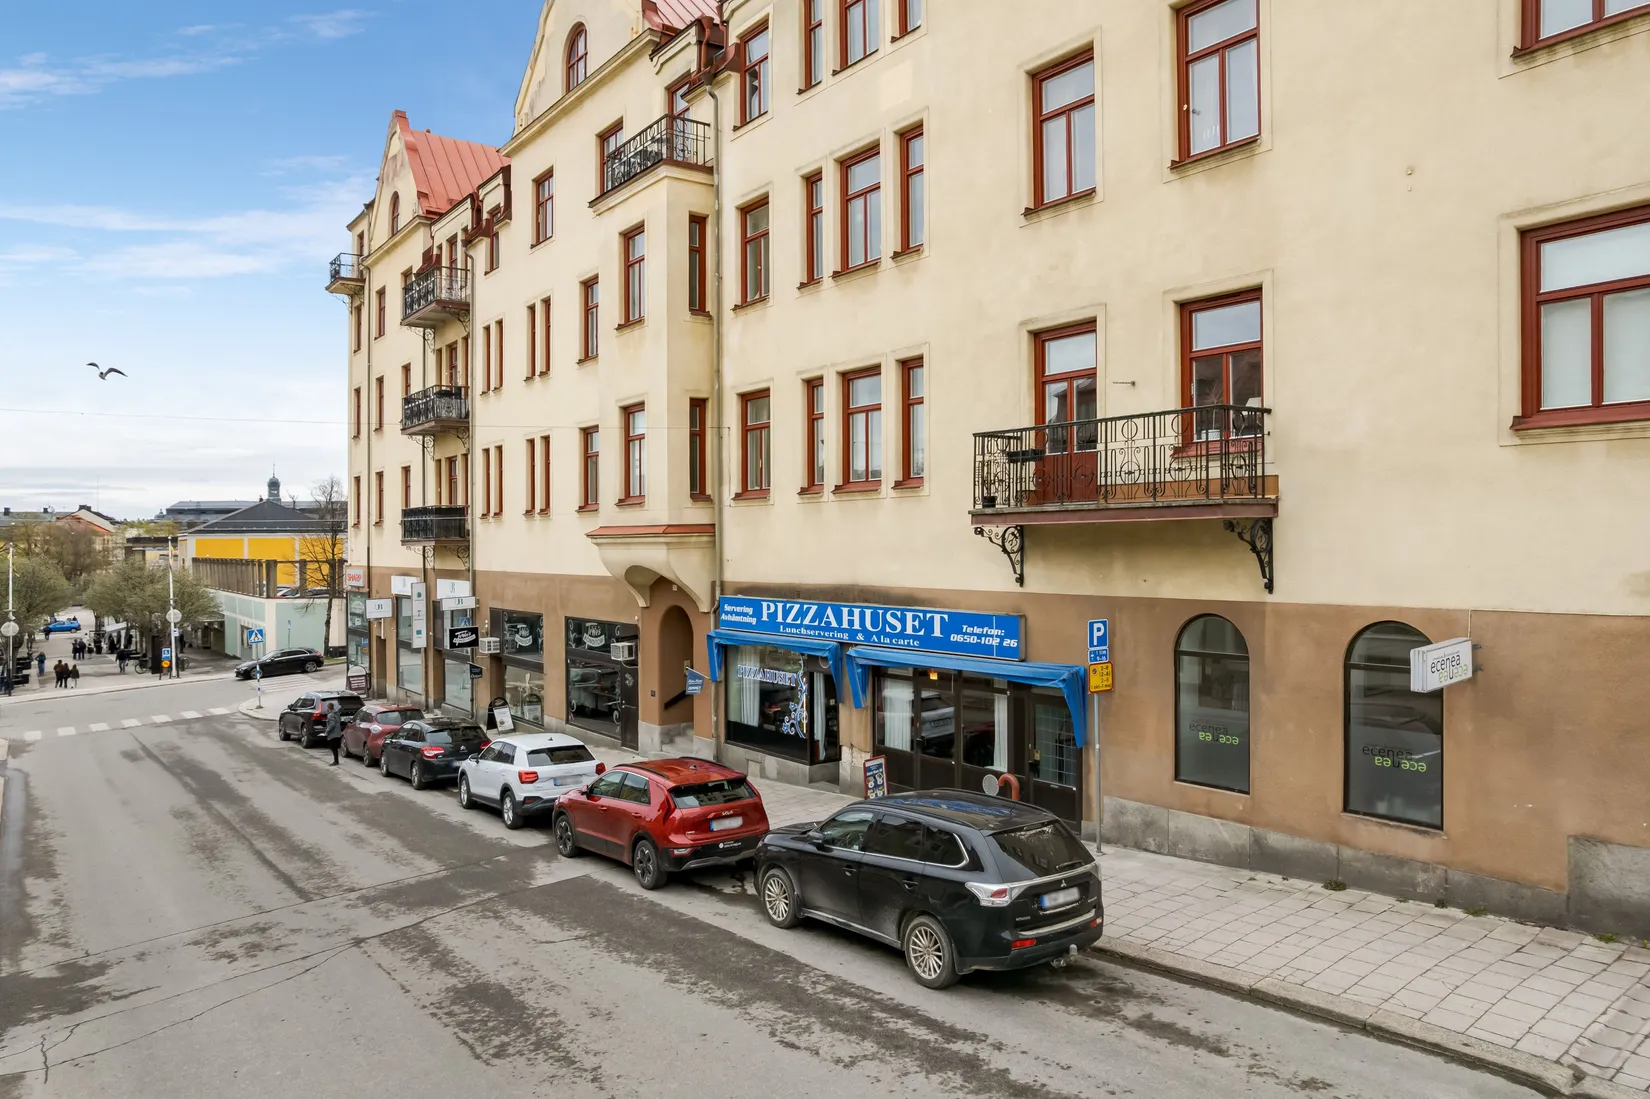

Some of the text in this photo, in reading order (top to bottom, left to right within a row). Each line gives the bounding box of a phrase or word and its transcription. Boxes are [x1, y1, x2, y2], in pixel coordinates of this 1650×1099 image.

[720, 613, 757, 625] Avhämtning
[723, 603, 754, 615] Servering
[760, 601, 949, 638] PIZZAHUSET
[780, 625, 920, 647] Lunchservering & A la carte
[950, 633, 1019, 648] 0650-102 26
[1093, 622, 1105, 646] P
[737, 664, 797, 687] PIZZAHUSET
[1430, 654, 1461, 679] ecenea
